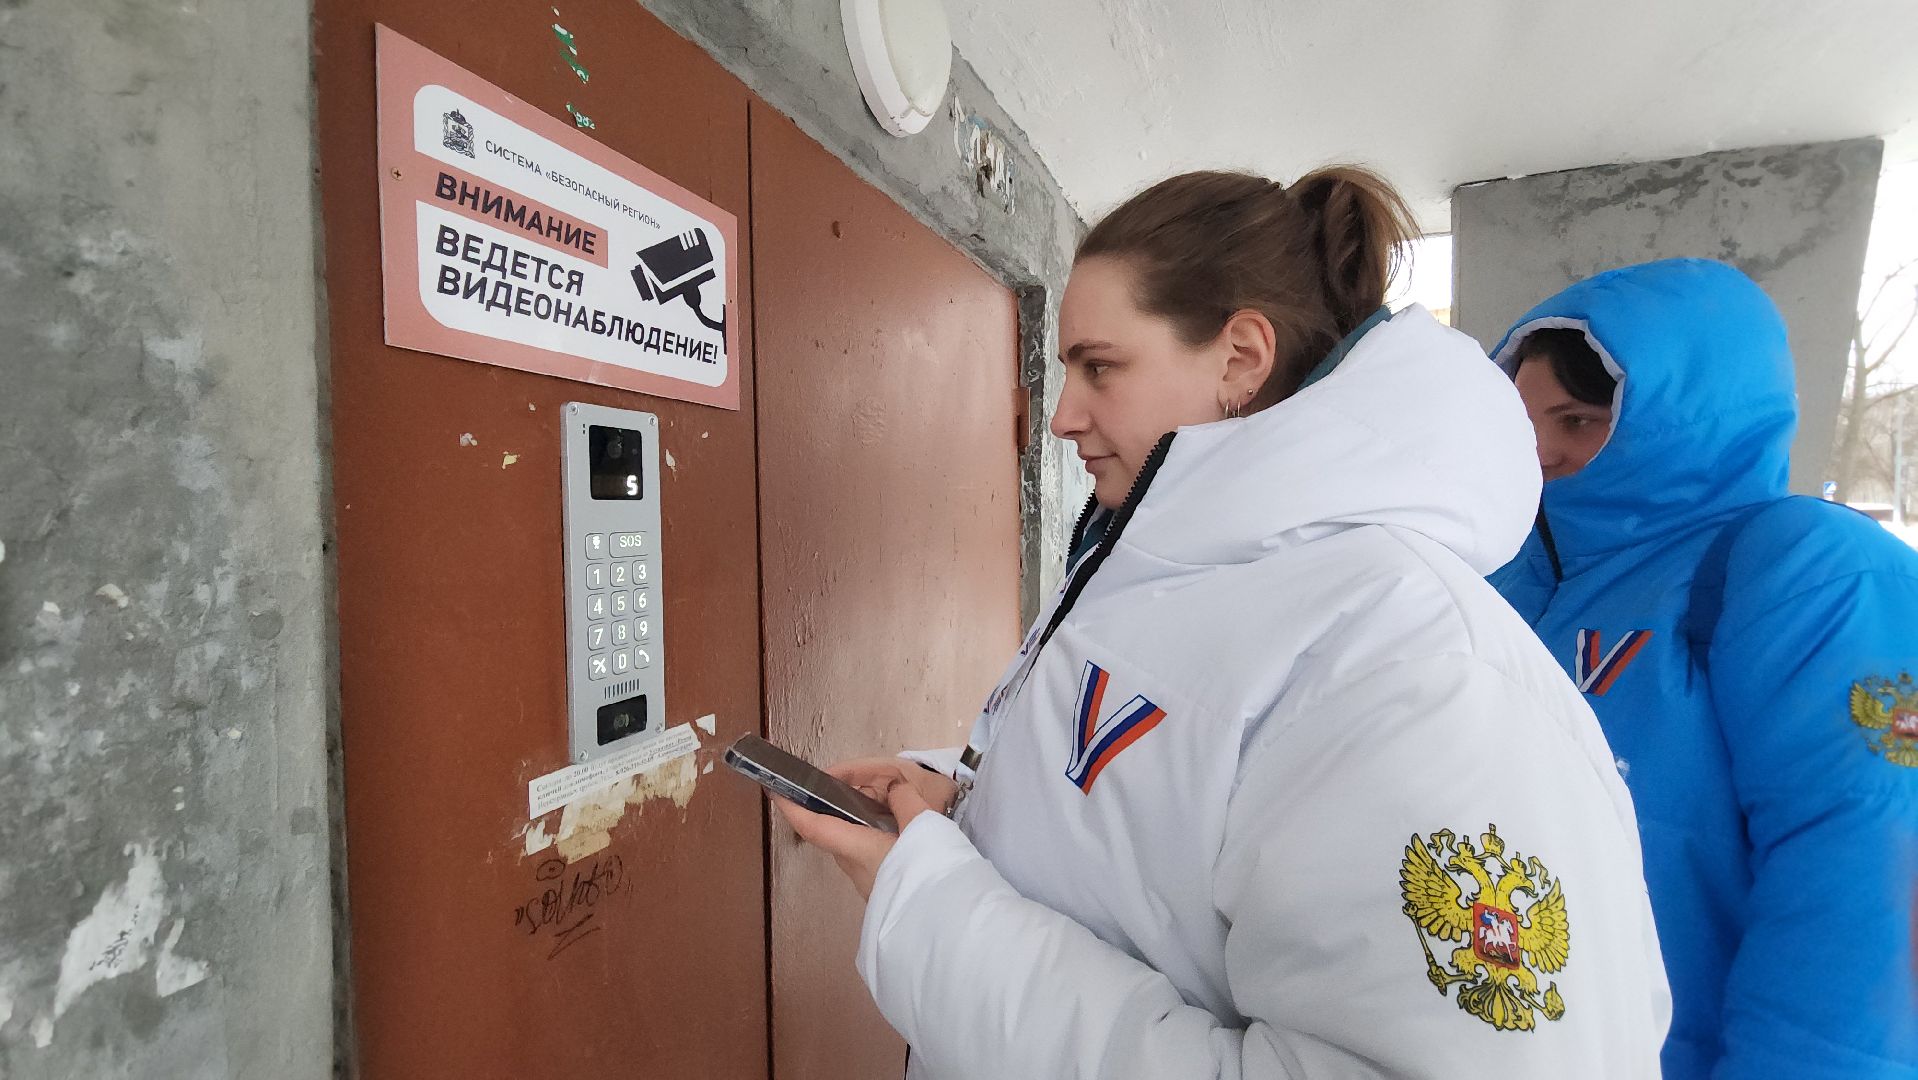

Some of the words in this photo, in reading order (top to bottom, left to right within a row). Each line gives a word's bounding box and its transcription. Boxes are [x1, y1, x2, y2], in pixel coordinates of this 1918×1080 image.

[485, 140, 542, 176] СИСТЕМА
[545, 170, 620, 212] «БЕЗОПАСНЫЙ
[622, 204, 661, 229] РЕГИОН»
[435, 171, 597, 255] ВНИМАНИЕ
[435, 224, 584, 297] ВЕДЕТСЯ
[437, 264, 718, 365] ВИДЕОНАБЛЮДЕНИЕ!
[619, 535, 642, 548] SOS
[593, 568, 600, 585] 1
[616, 566, 625, 583] 2
[638, 564, 647, 580] 3
[593, 598, 603, 615] 4
[617, 595, 626, 611] 5
[638, 592, 647, 608] 6
[593, 628, 604, 645] 7
[618, 624, 626, 640] 8
[639, 620, 648, 637] 9
[618, 653, 627, 670] 0
